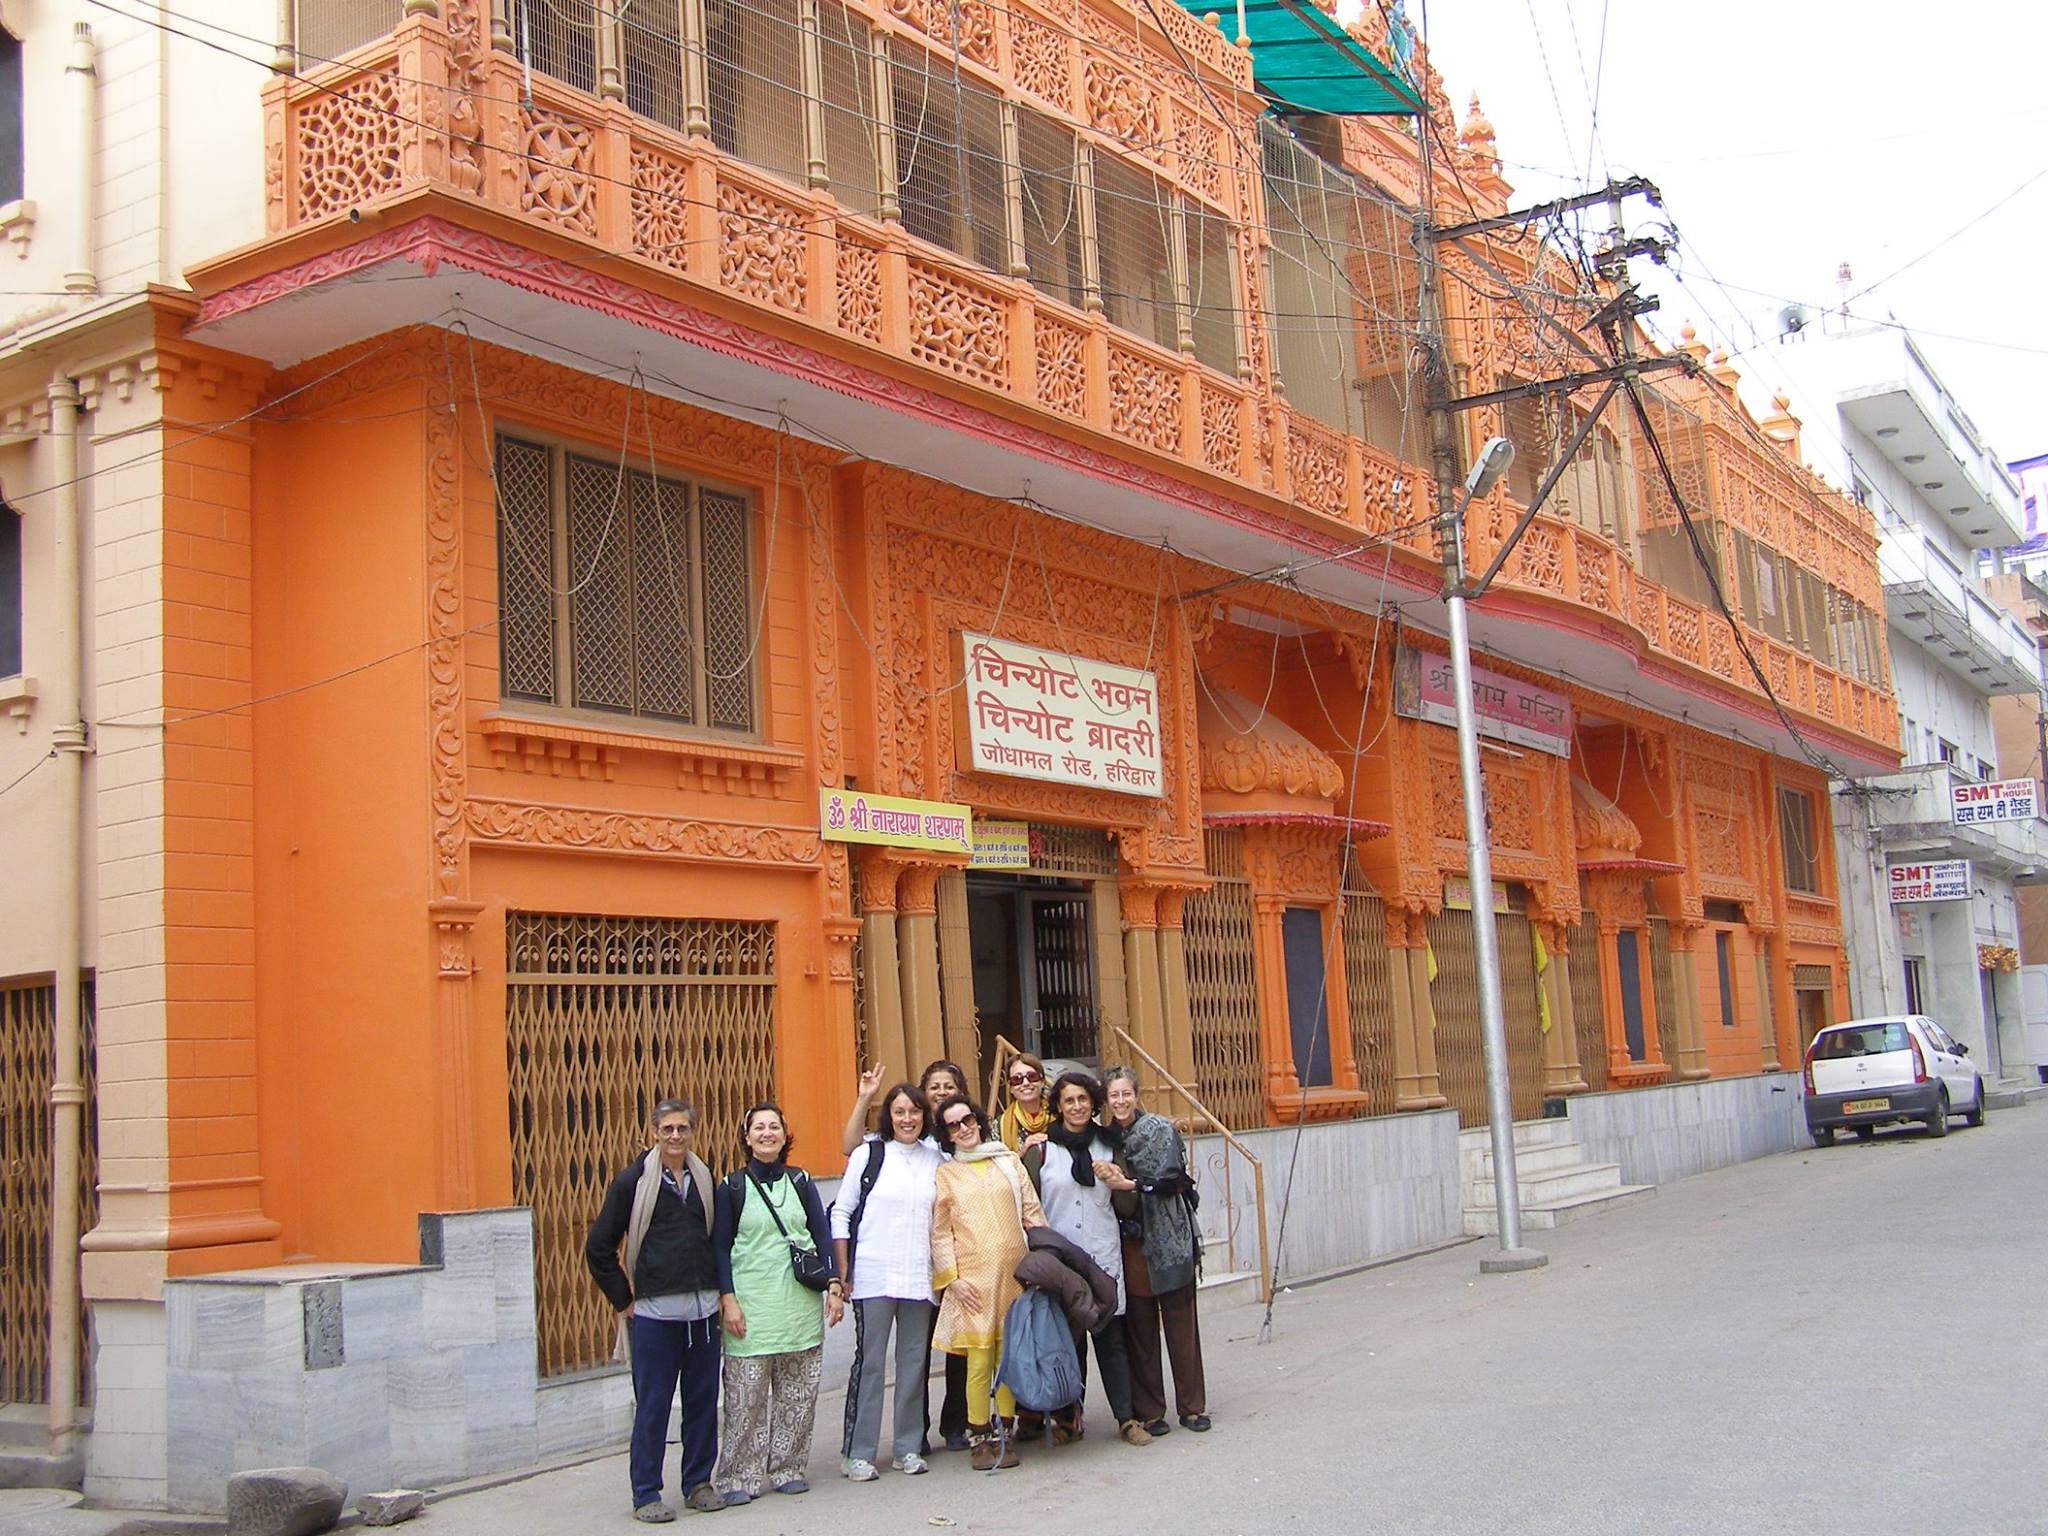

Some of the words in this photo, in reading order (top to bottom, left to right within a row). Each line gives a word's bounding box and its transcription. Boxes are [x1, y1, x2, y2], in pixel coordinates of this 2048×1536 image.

[971, 643, 1079, 698] चिन्योट
[1092, 678, 1152, 714] भवन
[975, 690, 1074, 743] चिन्योट
[1086, 720, 1155, 758] ब्रादरी
[980, 738, 1053, 771] जोधामल
[1061, 751, 1098, 780] रोड,
[1105, 759, 1156, 786] हरिद्वार
[1954, 784, 2003, 803] SMT
[2003, 789, 2032, 798] HOUSE
[2005, 781, 2032, 790] GUEST
[1956, 807, 1974, 822] एस
[1977, 805, 1994, 820] एम
[1996, 800, 2006, 818] टी
[850, 798, 867, 832] श्री
[871, 809, 920, 837] नारायण
[925, 815, 969, 849] शरणम्
[1890, 865, 1933, 881] SMT
